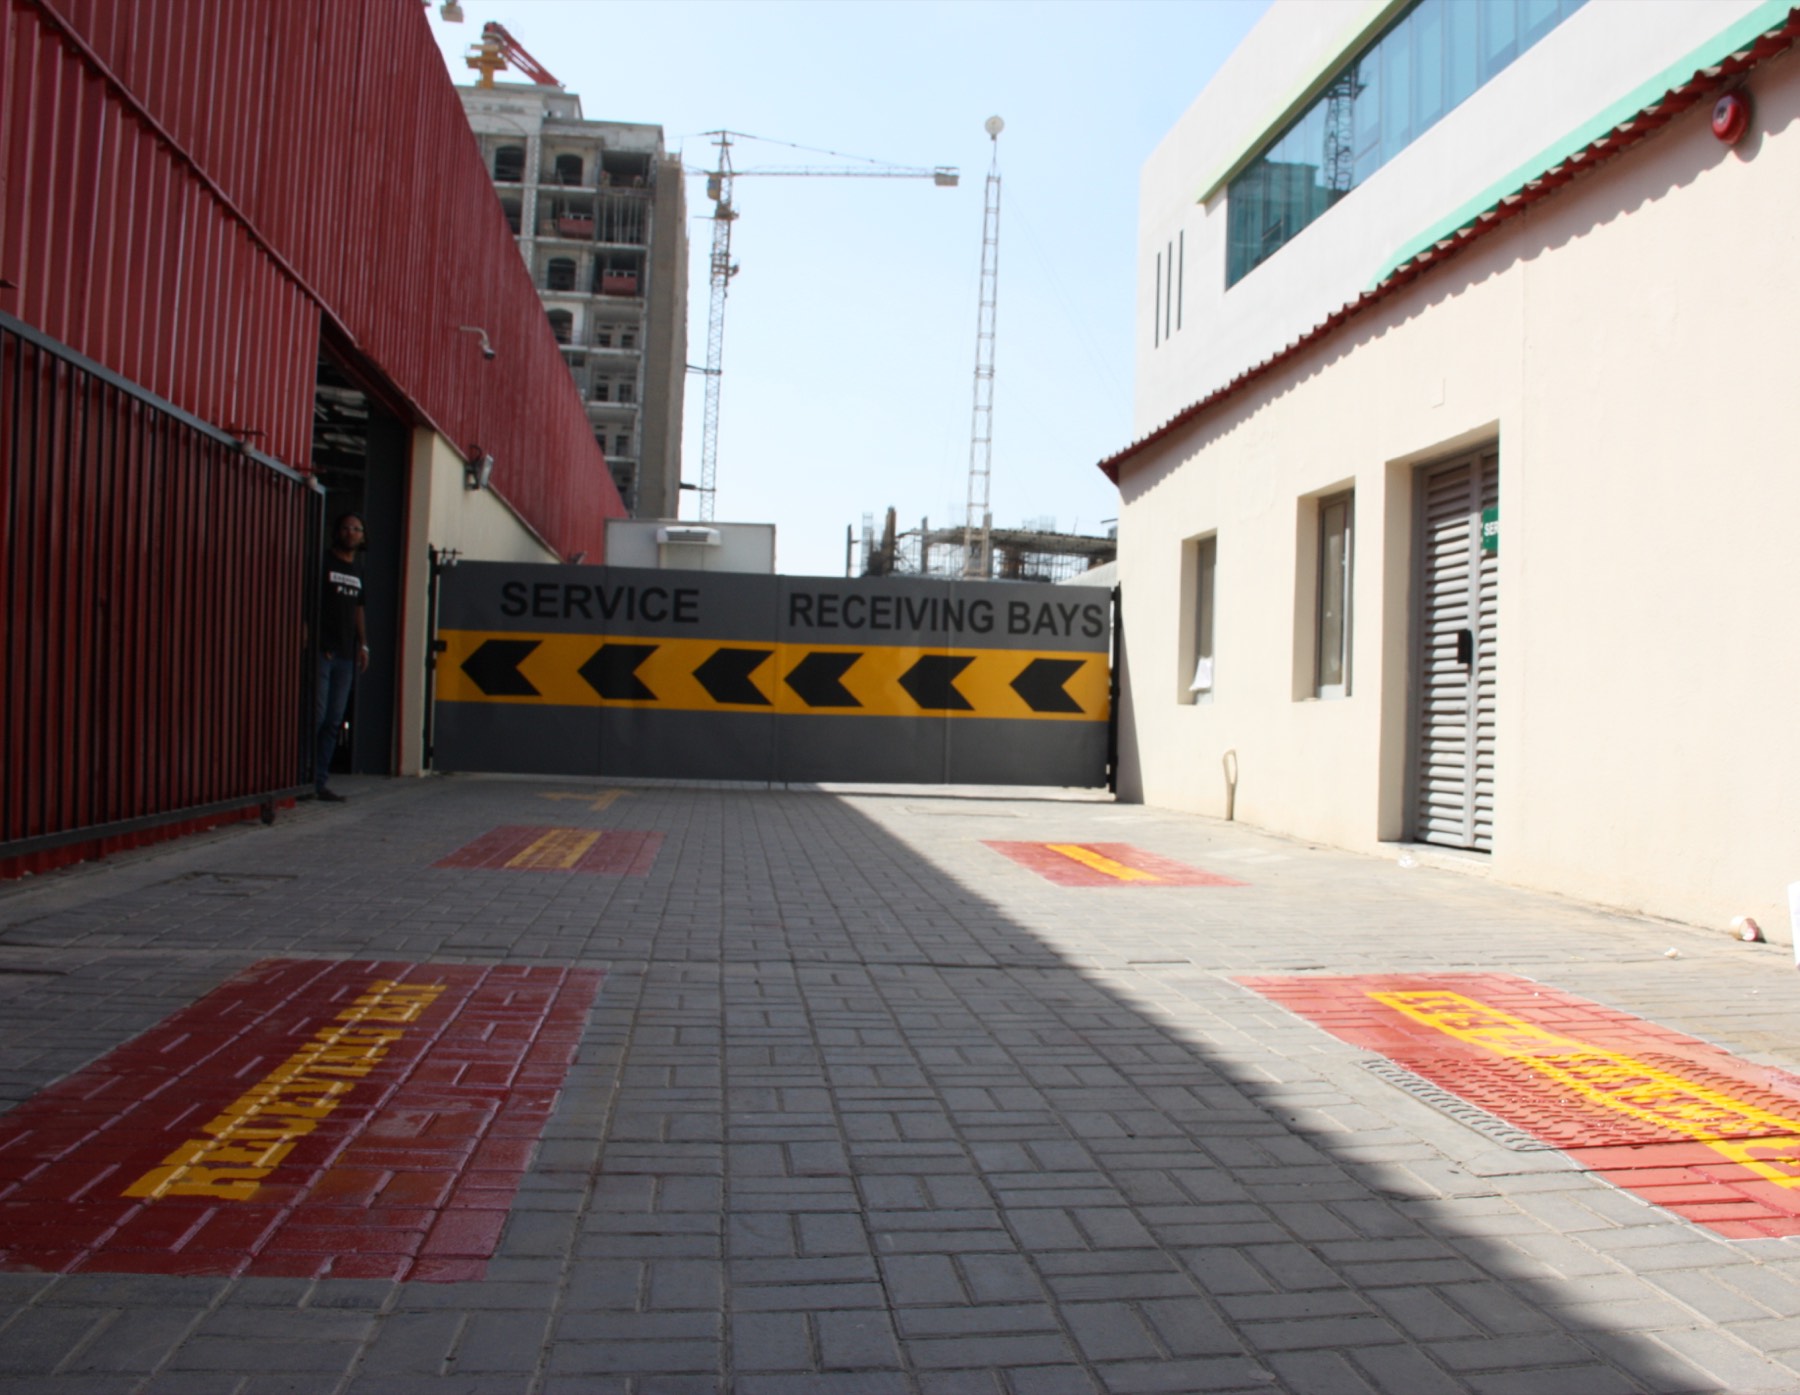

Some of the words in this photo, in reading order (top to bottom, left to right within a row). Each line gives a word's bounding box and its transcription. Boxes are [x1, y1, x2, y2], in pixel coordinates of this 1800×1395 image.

[500, 581, 700, 624] SERVICE
[788, 592, 994, 634] RECEIVING
[1007, 601, 1104, 638] BAYS
[120, 1027, 404, 1200] RECEIVING
